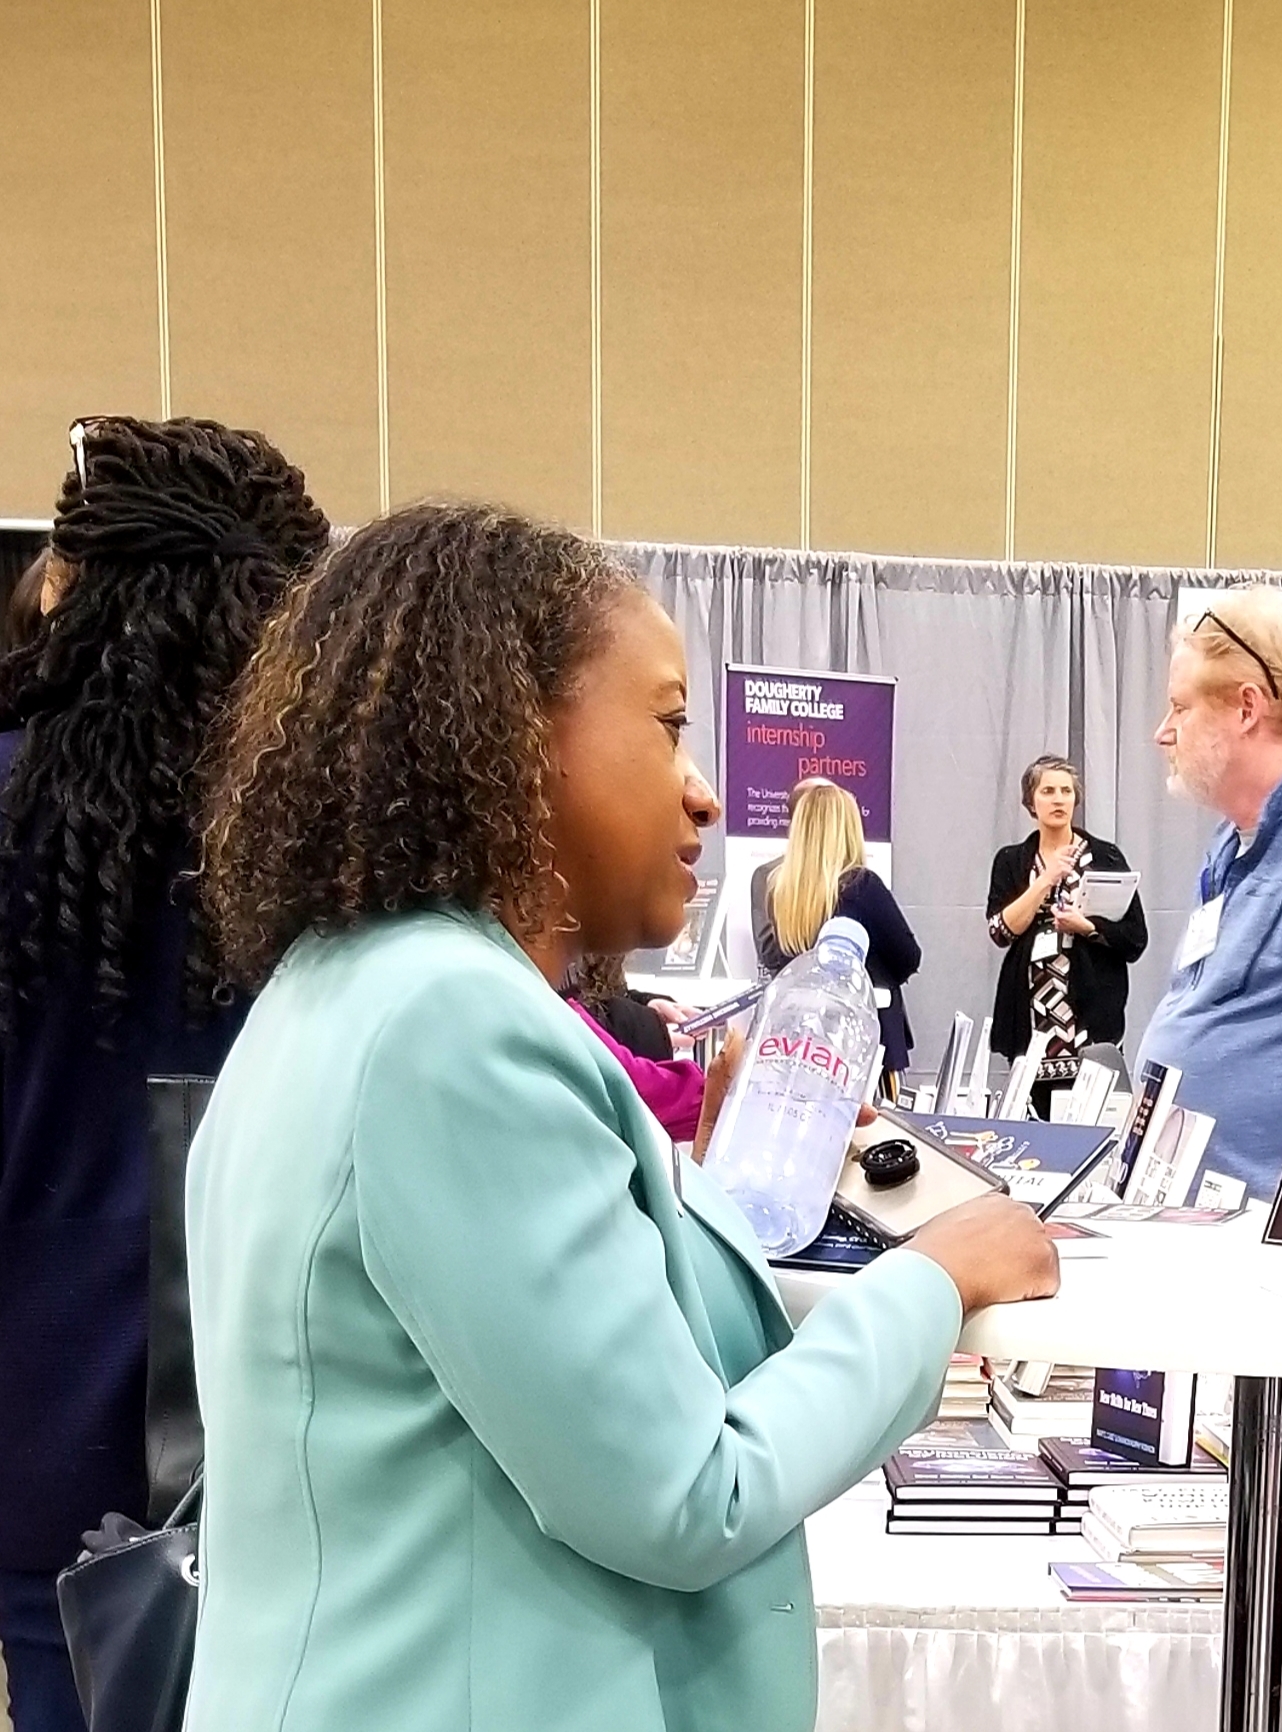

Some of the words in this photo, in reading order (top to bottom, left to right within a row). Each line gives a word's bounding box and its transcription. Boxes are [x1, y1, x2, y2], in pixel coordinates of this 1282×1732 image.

[744, 679, 823, 700] DOUGHERTY
[745, 698, 790, 716] FAMILY
[791, 703, 845, 720] COLLEGE
[747, 721, 825, 754] internship
[798, 755, 867, 780] partners
[759, 1036, 849, 1087] evian
